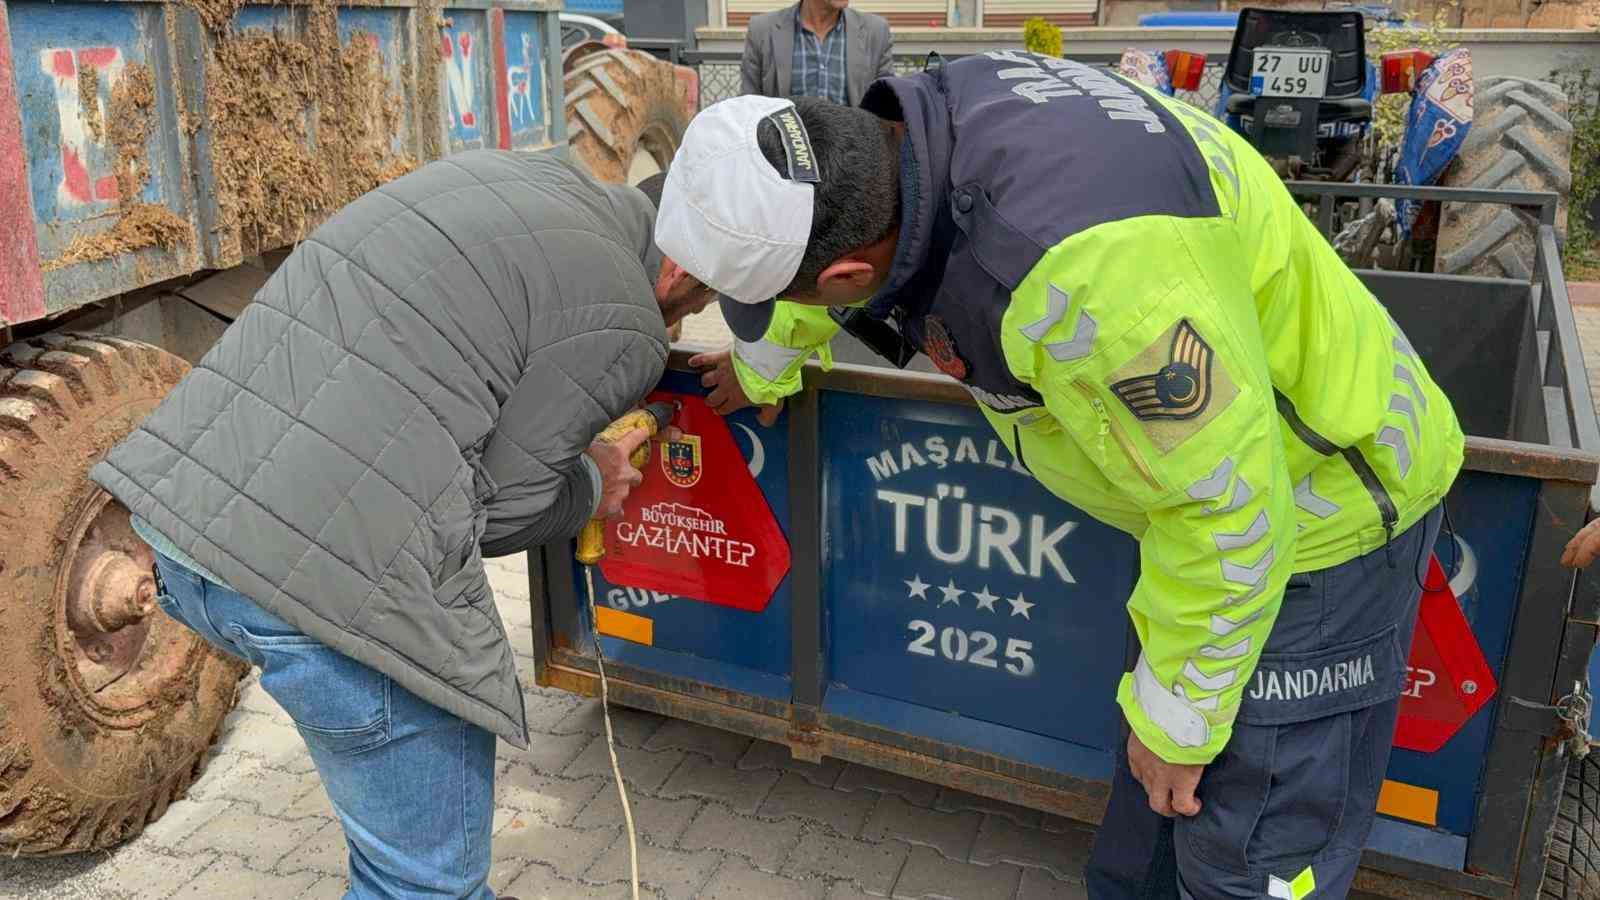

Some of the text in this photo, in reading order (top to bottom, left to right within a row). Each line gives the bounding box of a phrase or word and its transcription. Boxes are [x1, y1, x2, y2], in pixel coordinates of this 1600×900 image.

[1257, 55, 1323, 74] 27 UU
[1271, 76, 1308, 94] 459
[877, 483, 1078, 584] TÜRK
[907, 619, 1034, 677] 2025
[1250, 654, 1374, 701] JANDARMA
